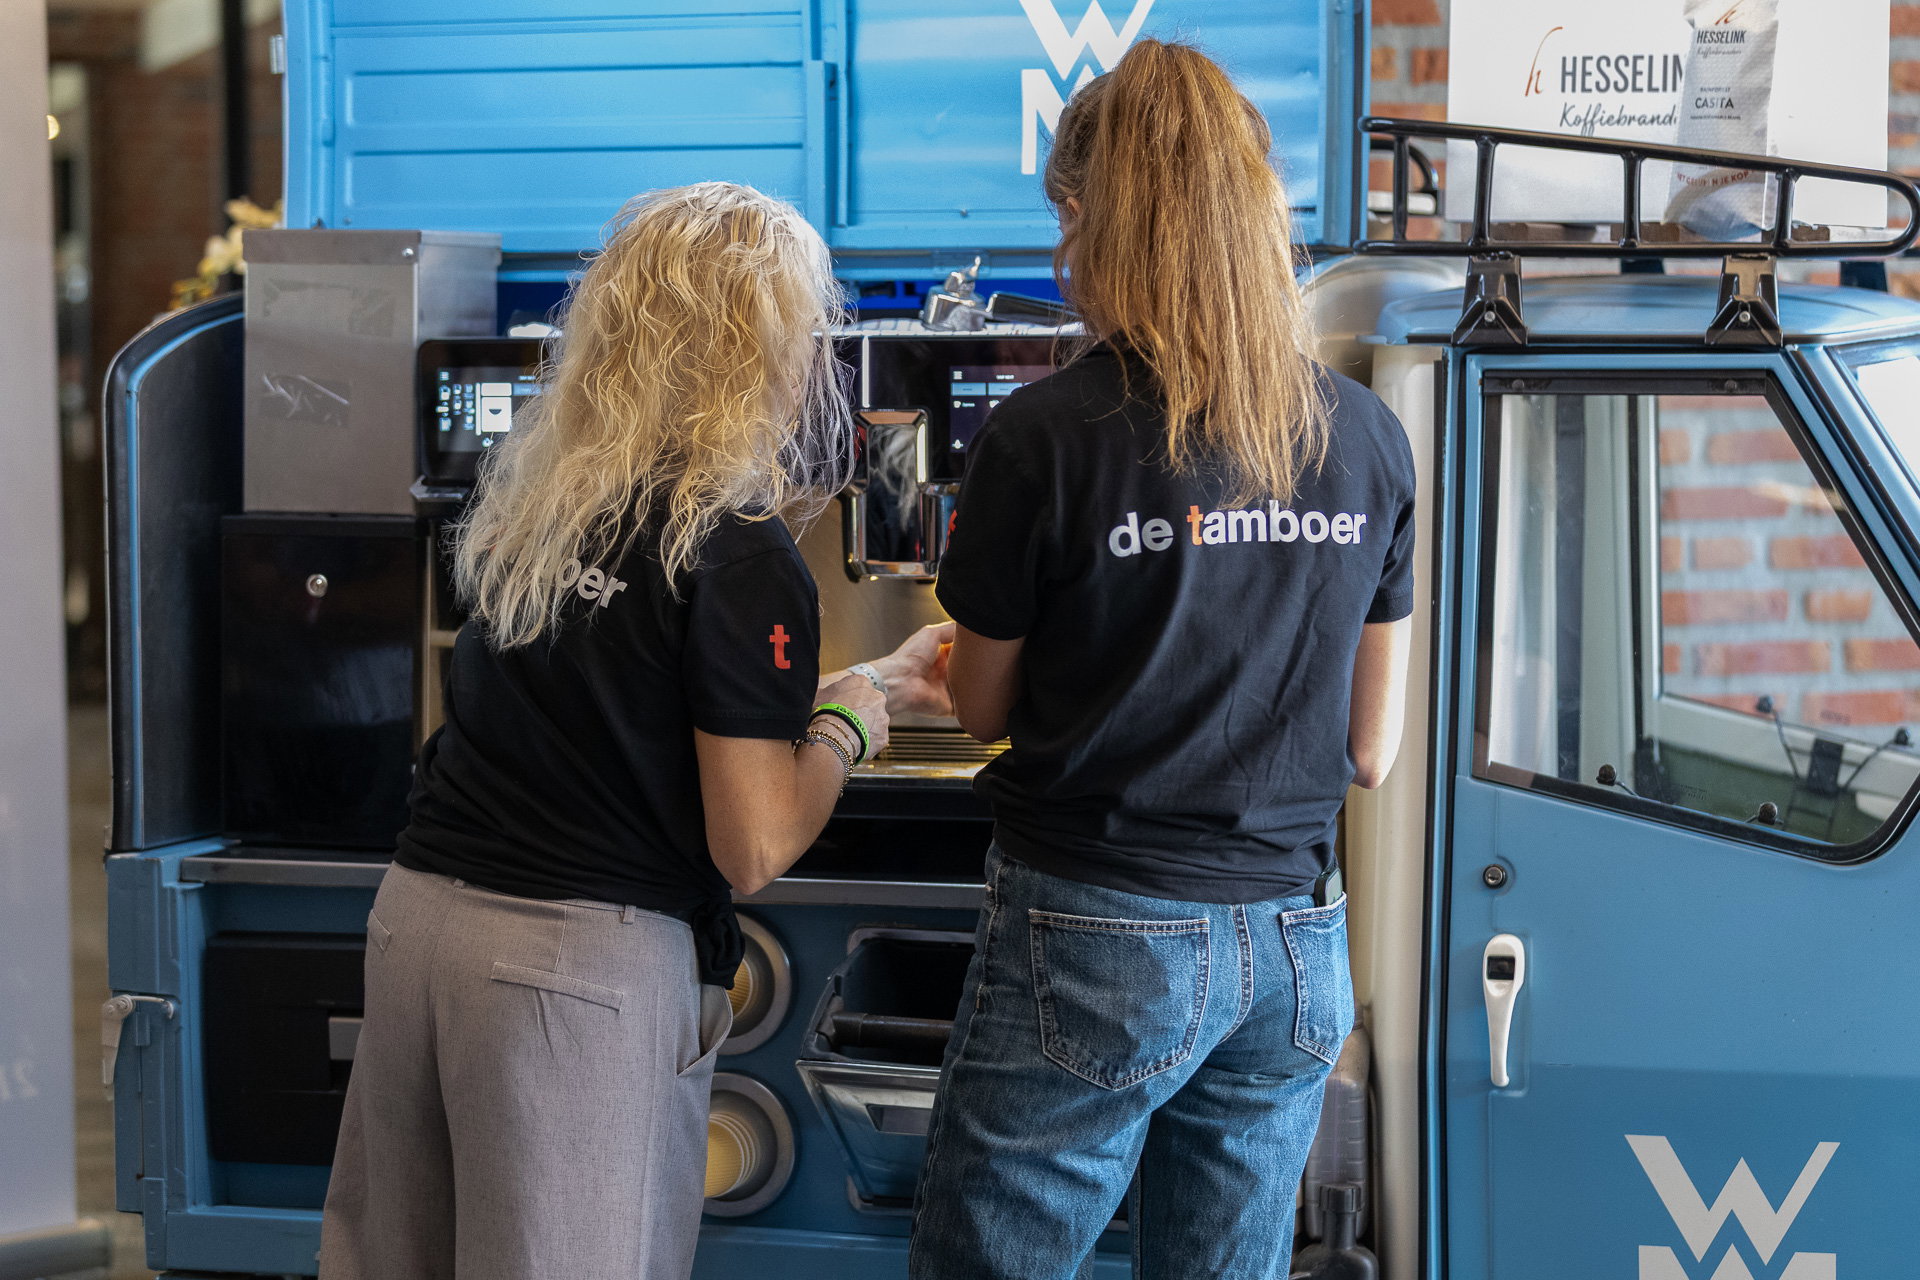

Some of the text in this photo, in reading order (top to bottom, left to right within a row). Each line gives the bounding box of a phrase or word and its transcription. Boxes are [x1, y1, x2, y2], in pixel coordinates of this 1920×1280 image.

[1696, 30, 1747, 44] HESSELINK
[1560, 54, 1683, 93] HESSELIN
[1559, 102, 1679, 137] Koffiebrand
[1695, 97, 1734, 109] CASITA
[1108, 500, 1366, 558] de tamboer
[555, 557, 628, 608] oer
[769, 624, 791, 670] t
